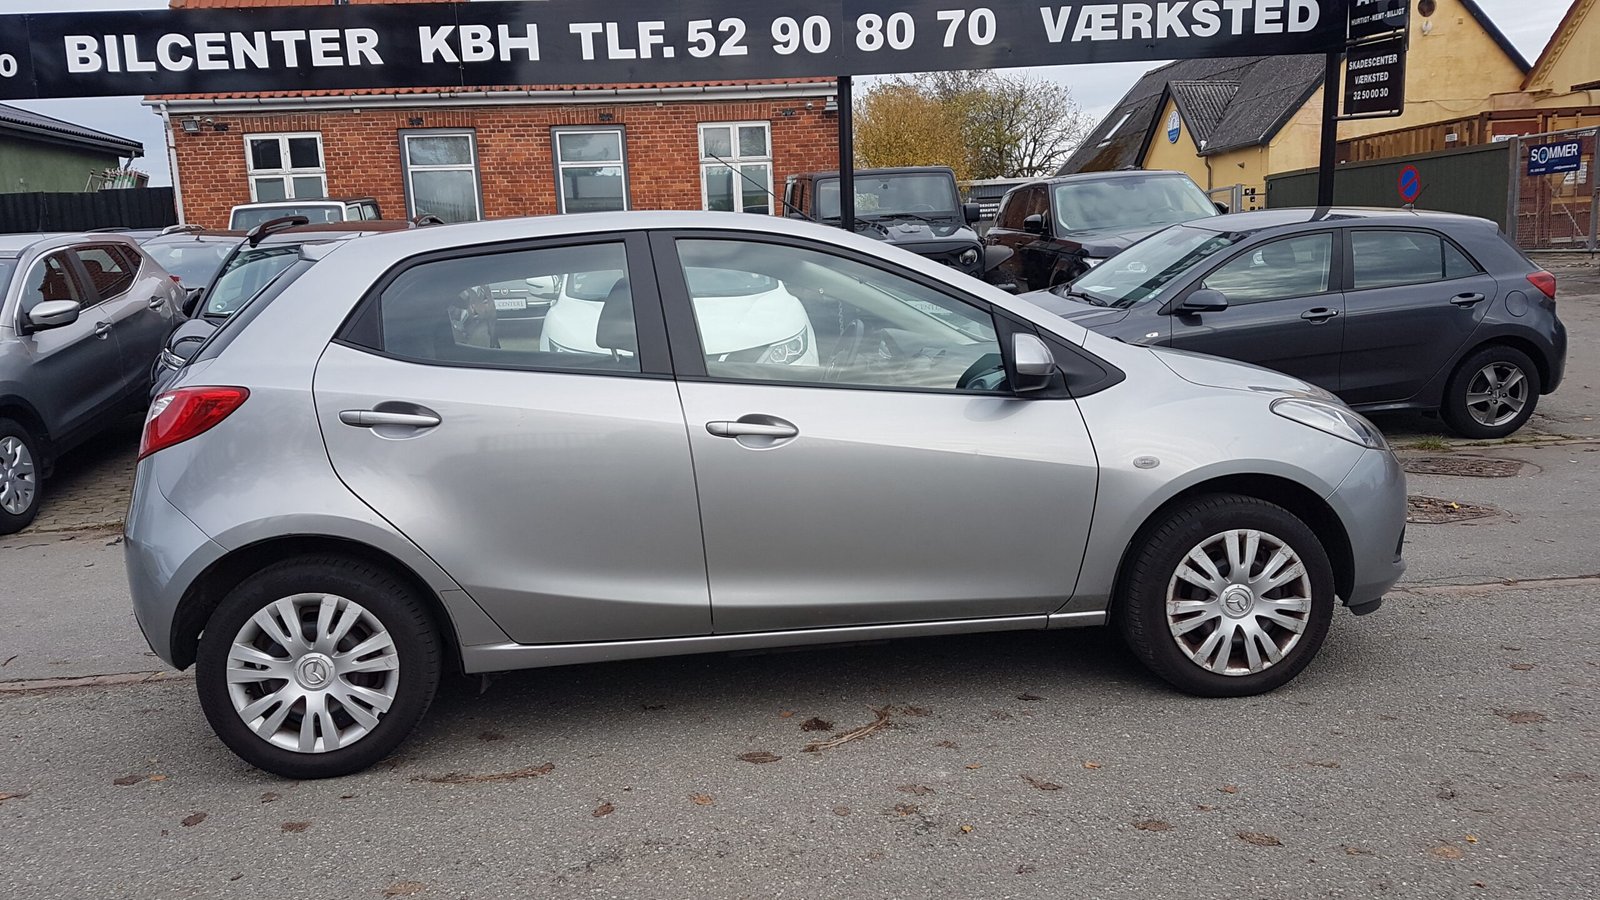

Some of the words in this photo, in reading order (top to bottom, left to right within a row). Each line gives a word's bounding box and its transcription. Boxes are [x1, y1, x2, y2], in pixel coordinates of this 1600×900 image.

[64, 28, 385, 73] BILCENTER
[418, 24, 540, 63] KBH
[771, 16, 831, 54] 90
[855, 12, 915, 51] 80
[937, 8, 997, 47] 70
[1040, 0, 1320, 43] VÆRKSTED
[1348, 54, 1398, 70] SKADESCENTER
[1354, 71, 1389, 85] VÆRKSTED
[1531, 143, 1578, 164] SOMMER
